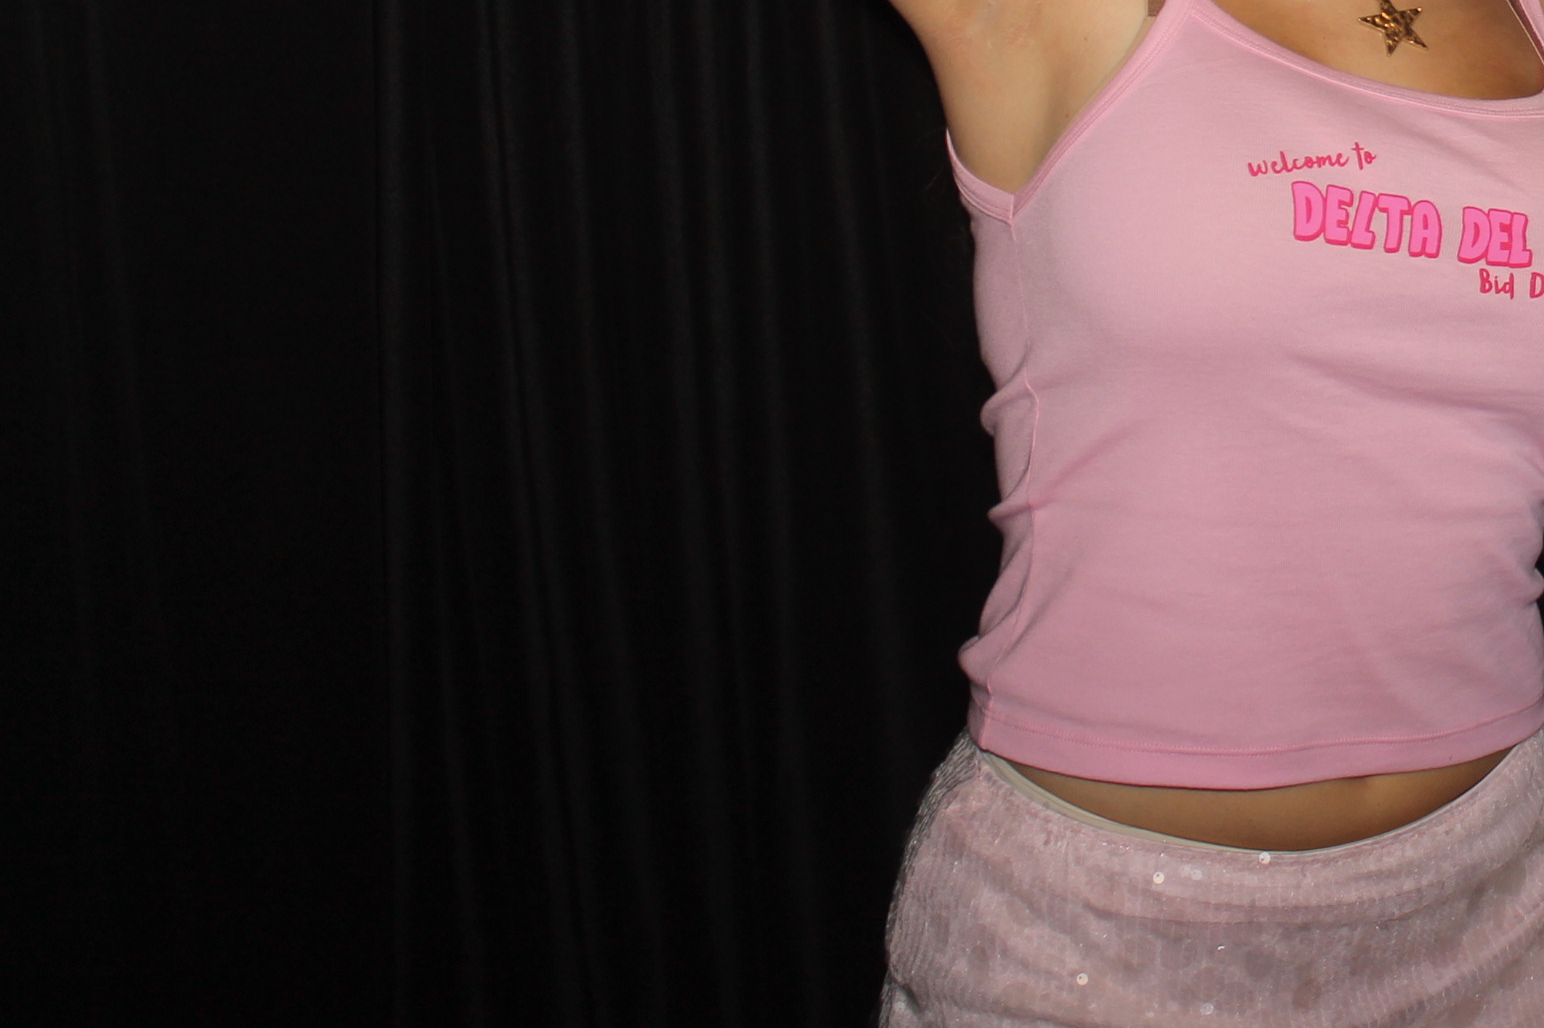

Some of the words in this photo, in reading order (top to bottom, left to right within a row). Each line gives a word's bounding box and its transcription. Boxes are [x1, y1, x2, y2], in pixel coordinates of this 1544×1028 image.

[1248, 150, 1349, 177] welcome
[1352, 142, 1376, 170] to
[1291, 180, 1442, 258] DELTA
[1457, 206, 1533, 268] DEL
[1479, 269, 1514, 299] Bid
